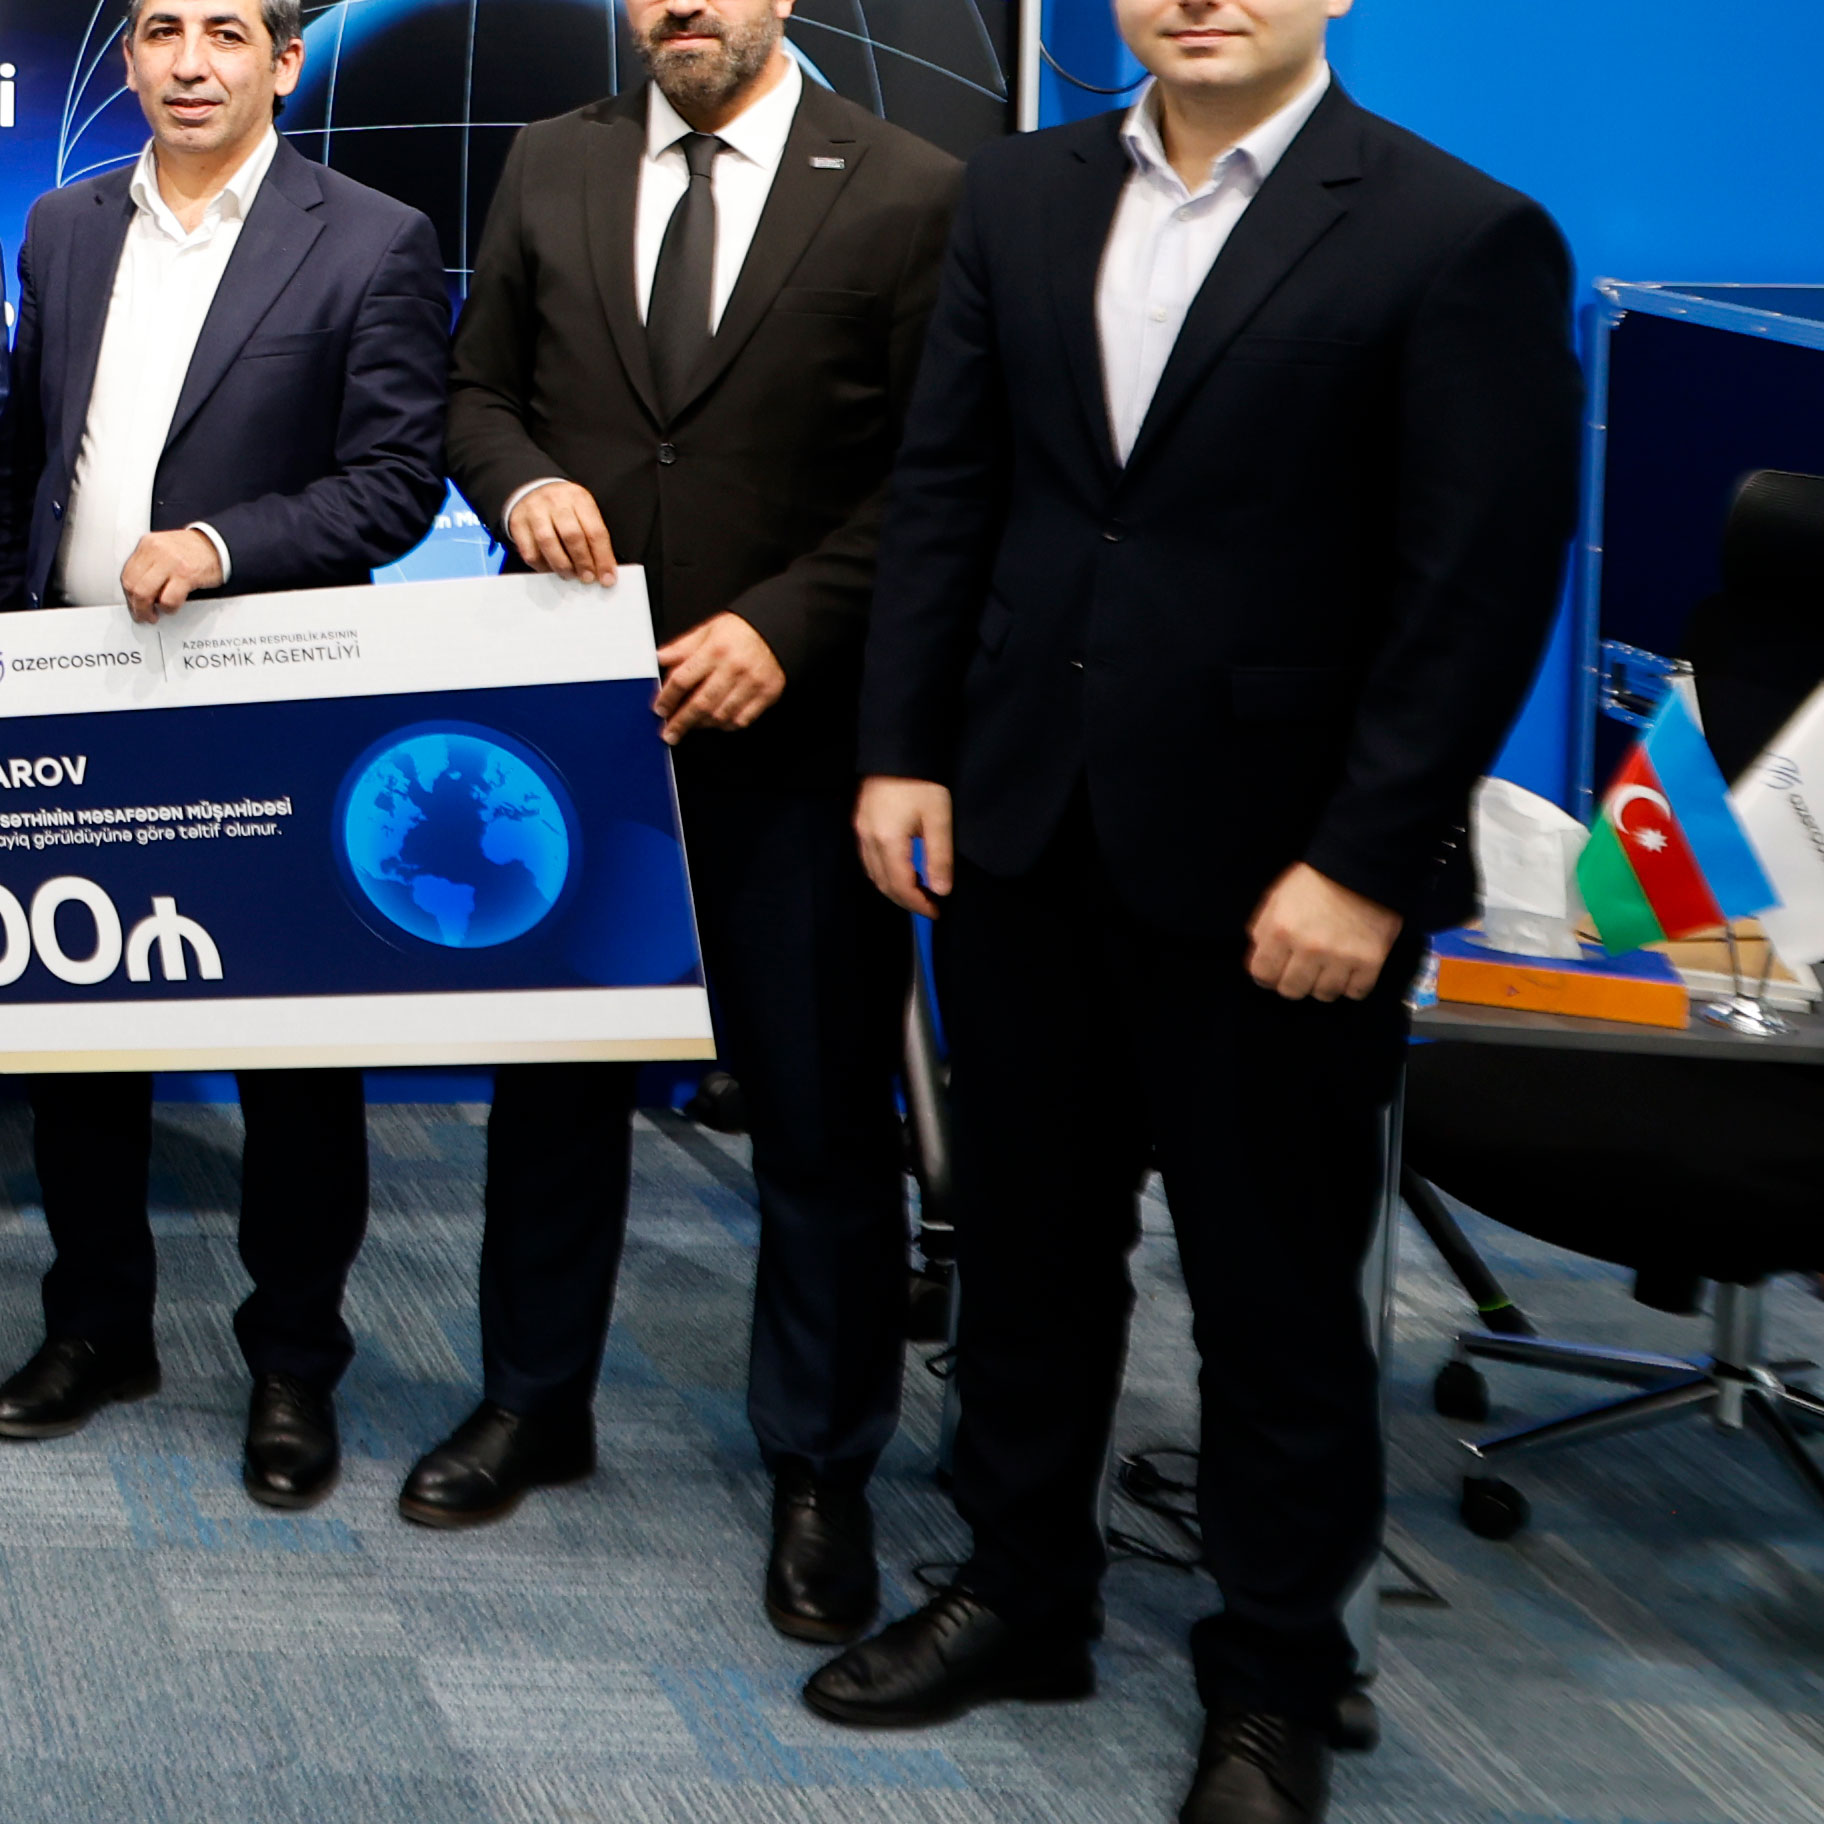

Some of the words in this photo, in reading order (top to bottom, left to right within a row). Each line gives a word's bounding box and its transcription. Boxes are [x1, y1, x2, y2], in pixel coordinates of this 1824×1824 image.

[11, 650, 143, 673] azercosmos
[183, 648, 255, 671] KOSMİK
[262, 640, 361, 666] AGENTLİYİ
[0, 807, 75, 829] SƏTHİNİN
[135, 825, 175, 846] görə
[224, 820, 283, 839] olunur.
